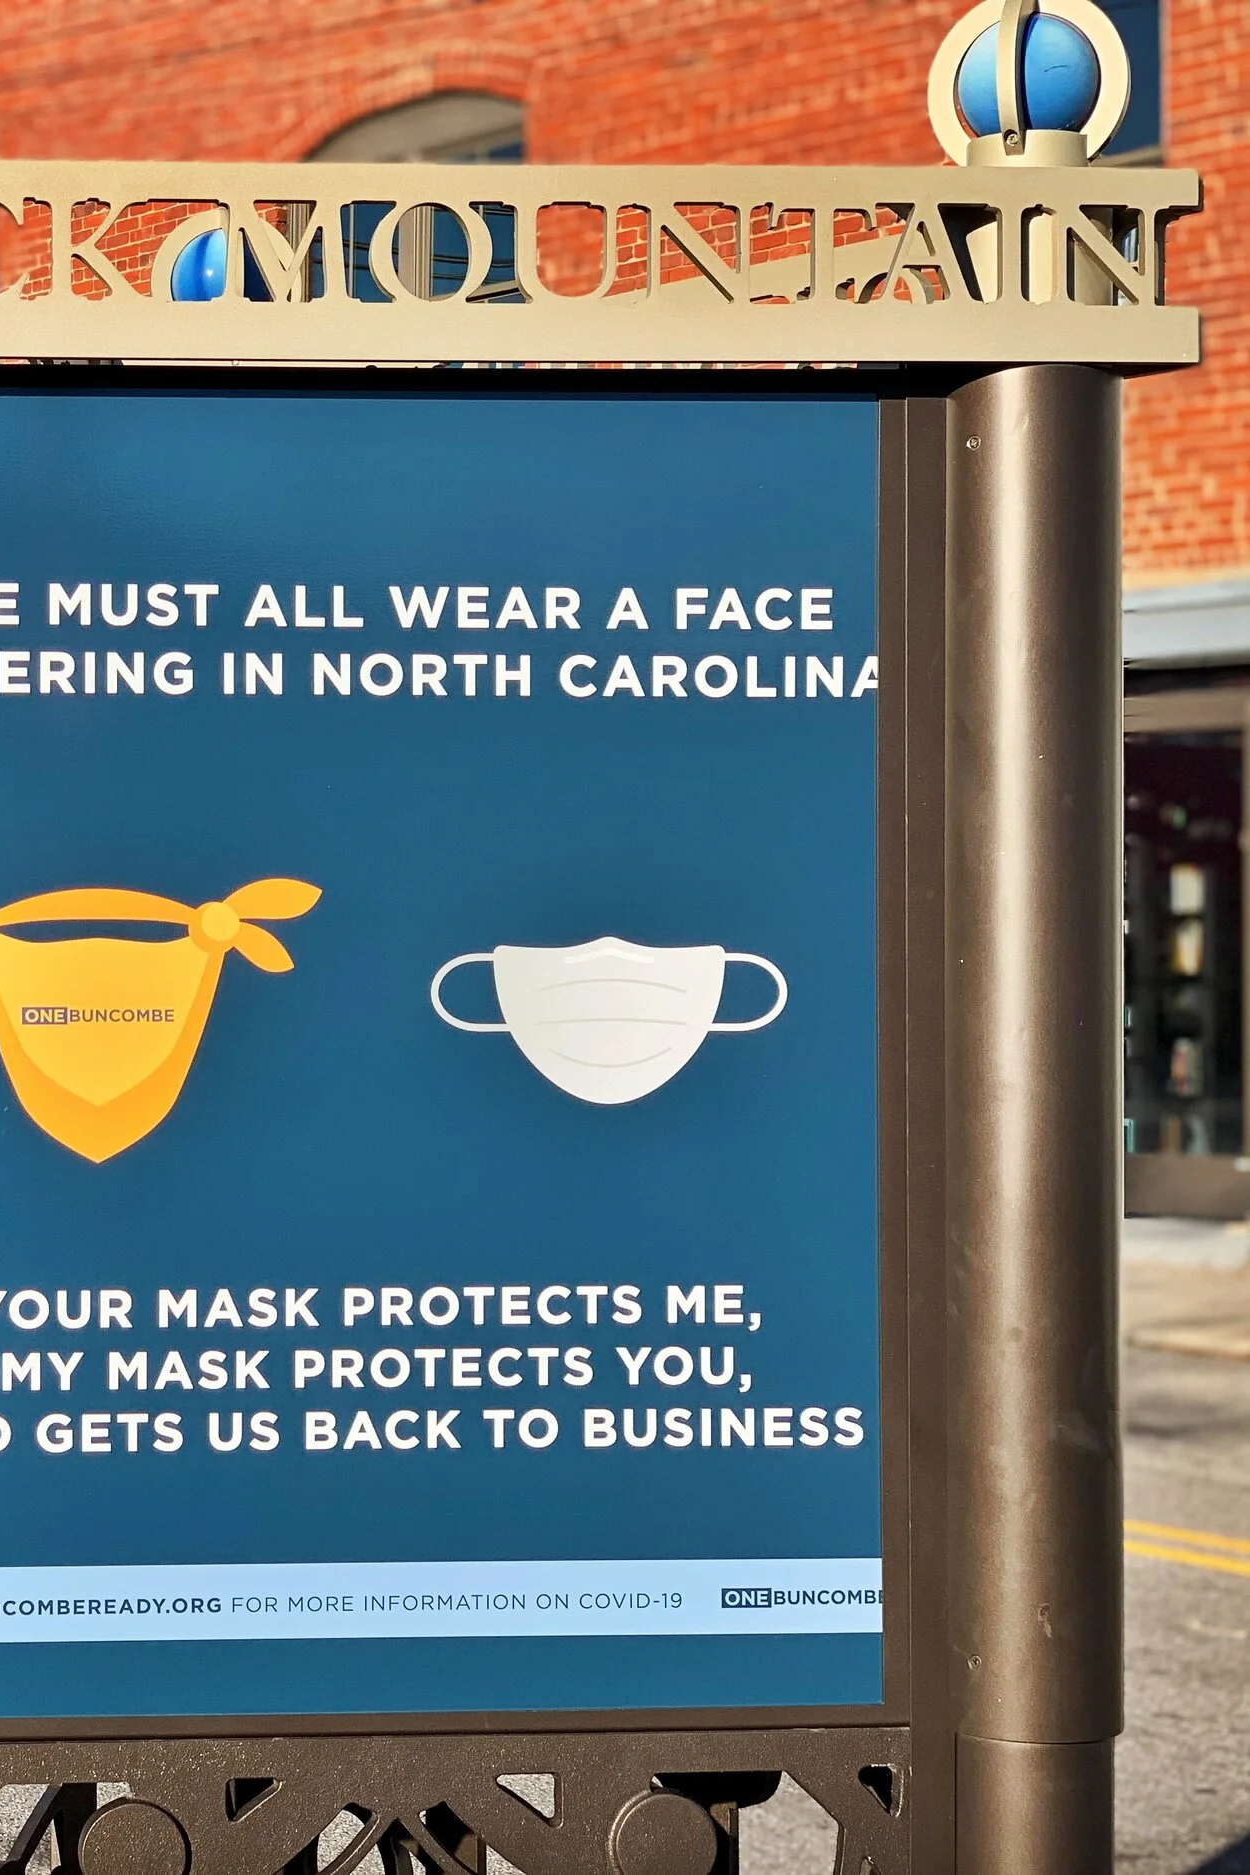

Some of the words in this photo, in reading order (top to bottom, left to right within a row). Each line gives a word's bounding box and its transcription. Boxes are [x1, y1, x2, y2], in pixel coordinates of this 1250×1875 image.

[219, 197, 1168, 305] MOUNTAIN
[49, 583, 219, 626] MUST
[245, 585, 363, 627] ALL
[389, 586, 580, 629] WEAR
[607, 588, 648, 629] A
[677, 588, 832, 630] FACE
[224, 653, 282, 694] IN
[314, 653, 530, 696] NORTH
[560, 655, 879, 697] CAROLINA
[159, 1288, 319, 1327] MASK
[344, 1285, 641, 1326] PROTECTS
[668, 1285, 760, 1331] ME,
[2, 1352, 83, 1391] MY
[109, 1351, 269, 1390] MASK
[295, 1347, 593, 1388] PROTECTS
[616, 1347, 751, 1392] YOU,
[37, 1413, 183, 1453] GETS
[209, 1412, 279, 1451] US
[306, 1410, 461, 1449] BACK
[483, 1409, 558, 1448] TO
[585, 1407, 863, 1447] BUSINESS
[232, 1596, 278, 1614] FOR
[288, 1595, 354, 1613] MORE
[364, 1593, 526, 1612] INFORMATION
[535, 1593, 569, 1610] ON
[579, 1592, 683, 1610] COVID-19
